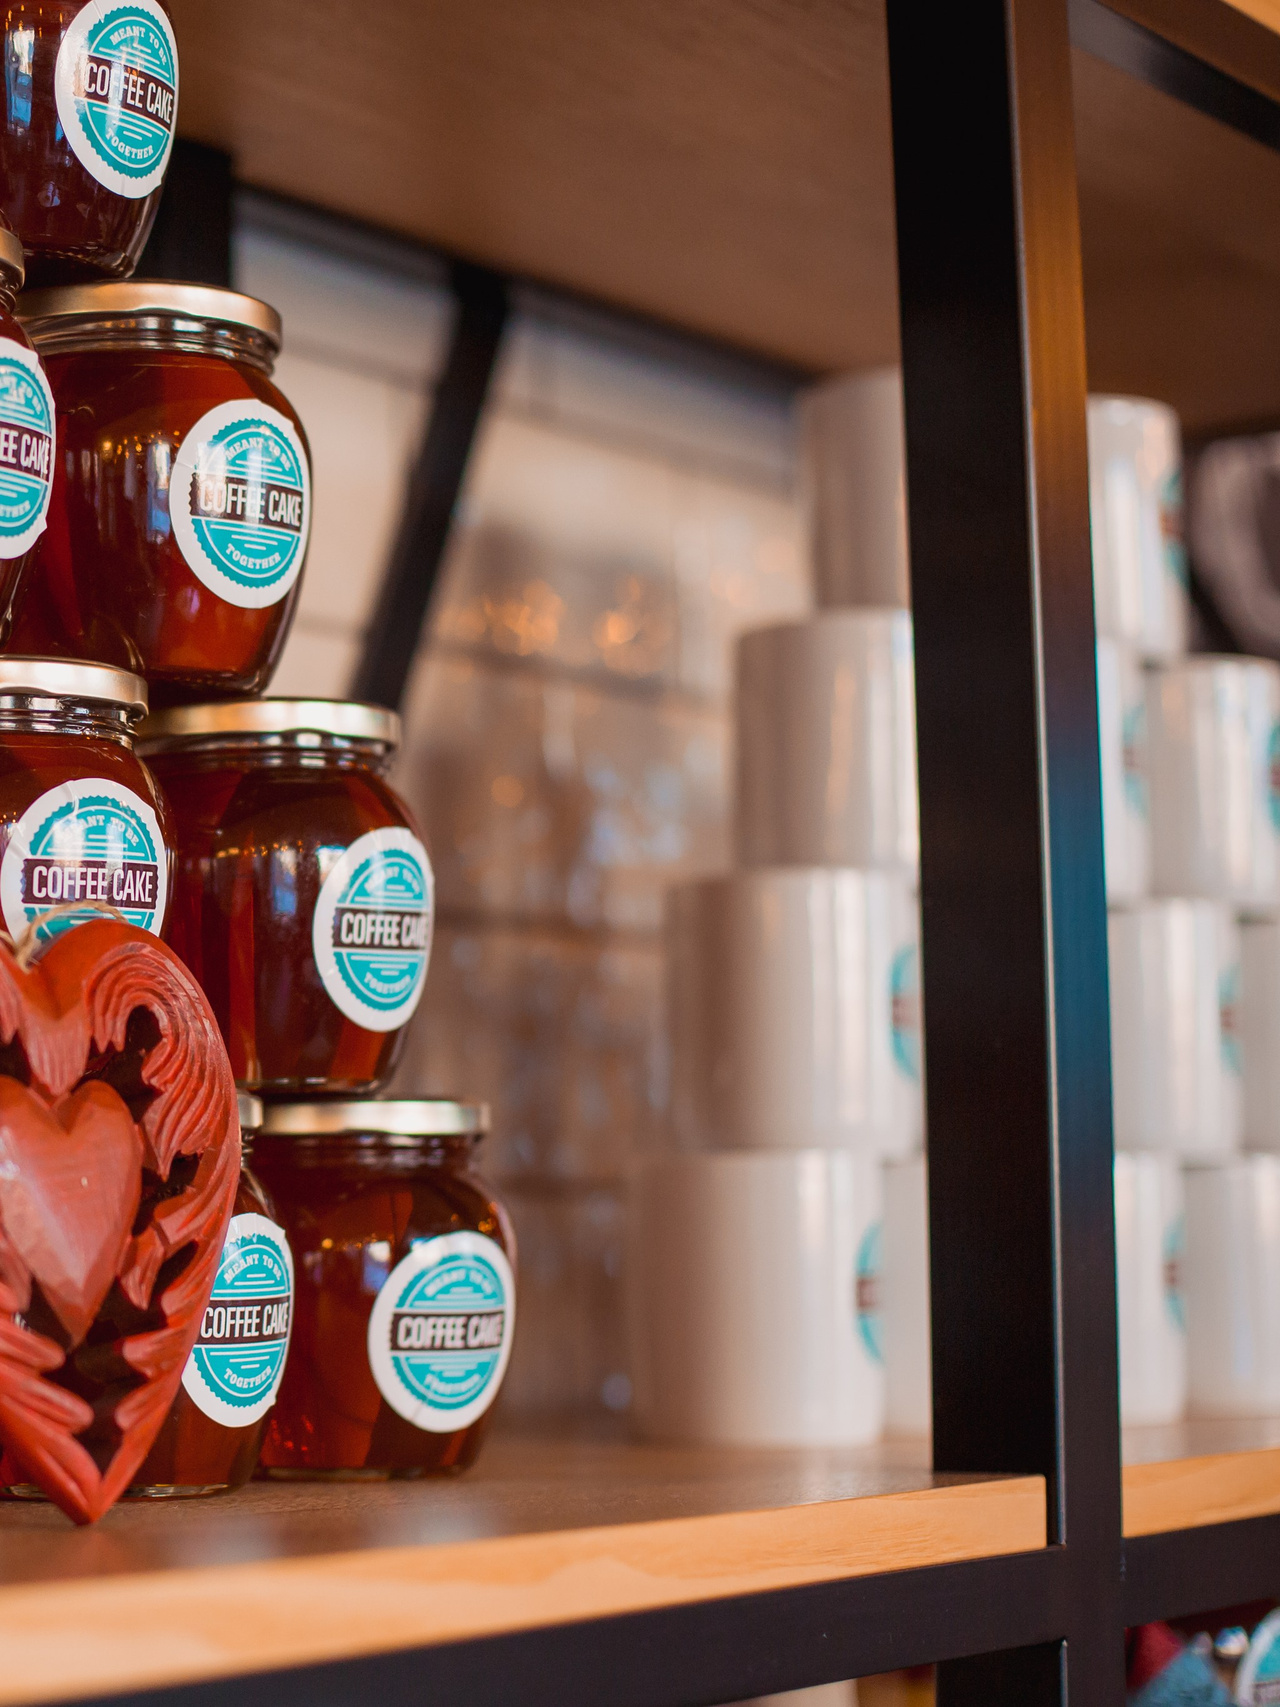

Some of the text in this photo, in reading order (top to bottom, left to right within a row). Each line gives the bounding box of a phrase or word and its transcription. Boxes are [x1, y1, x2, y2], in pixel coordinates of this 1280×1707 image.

[109, 26, 146, 46] MEANT
[149, 32, 160, 49] TO
[85, 62, 174, 124] COFFEE CAKE
[105, 128, 154, 160] TOGETHER
[20, 433, 50, 475] CAKE
[225, 437, 264, 462] MEANT
[268, 440, 281, 457] TO
[199, 480, 302, 527] COFFEE CAKE
[225, 543, 282, 570] TOGETHER
[111, 816, 125, 831] TO
[126, 827, 140, 846] BE
[32, 865, 153, 903] COFFEE CAKE
[340, 912, 401, 947] COFFEE
[223, 1254, 260, 1284] MEANT
[263, 1255, 274, 1270] TO
[201, 1301, 289, 1339] COFFEE CAKE
[397, 1316, 468, 1349] COFFEE
[224, 1366, 271, 1389] TOGETHER
